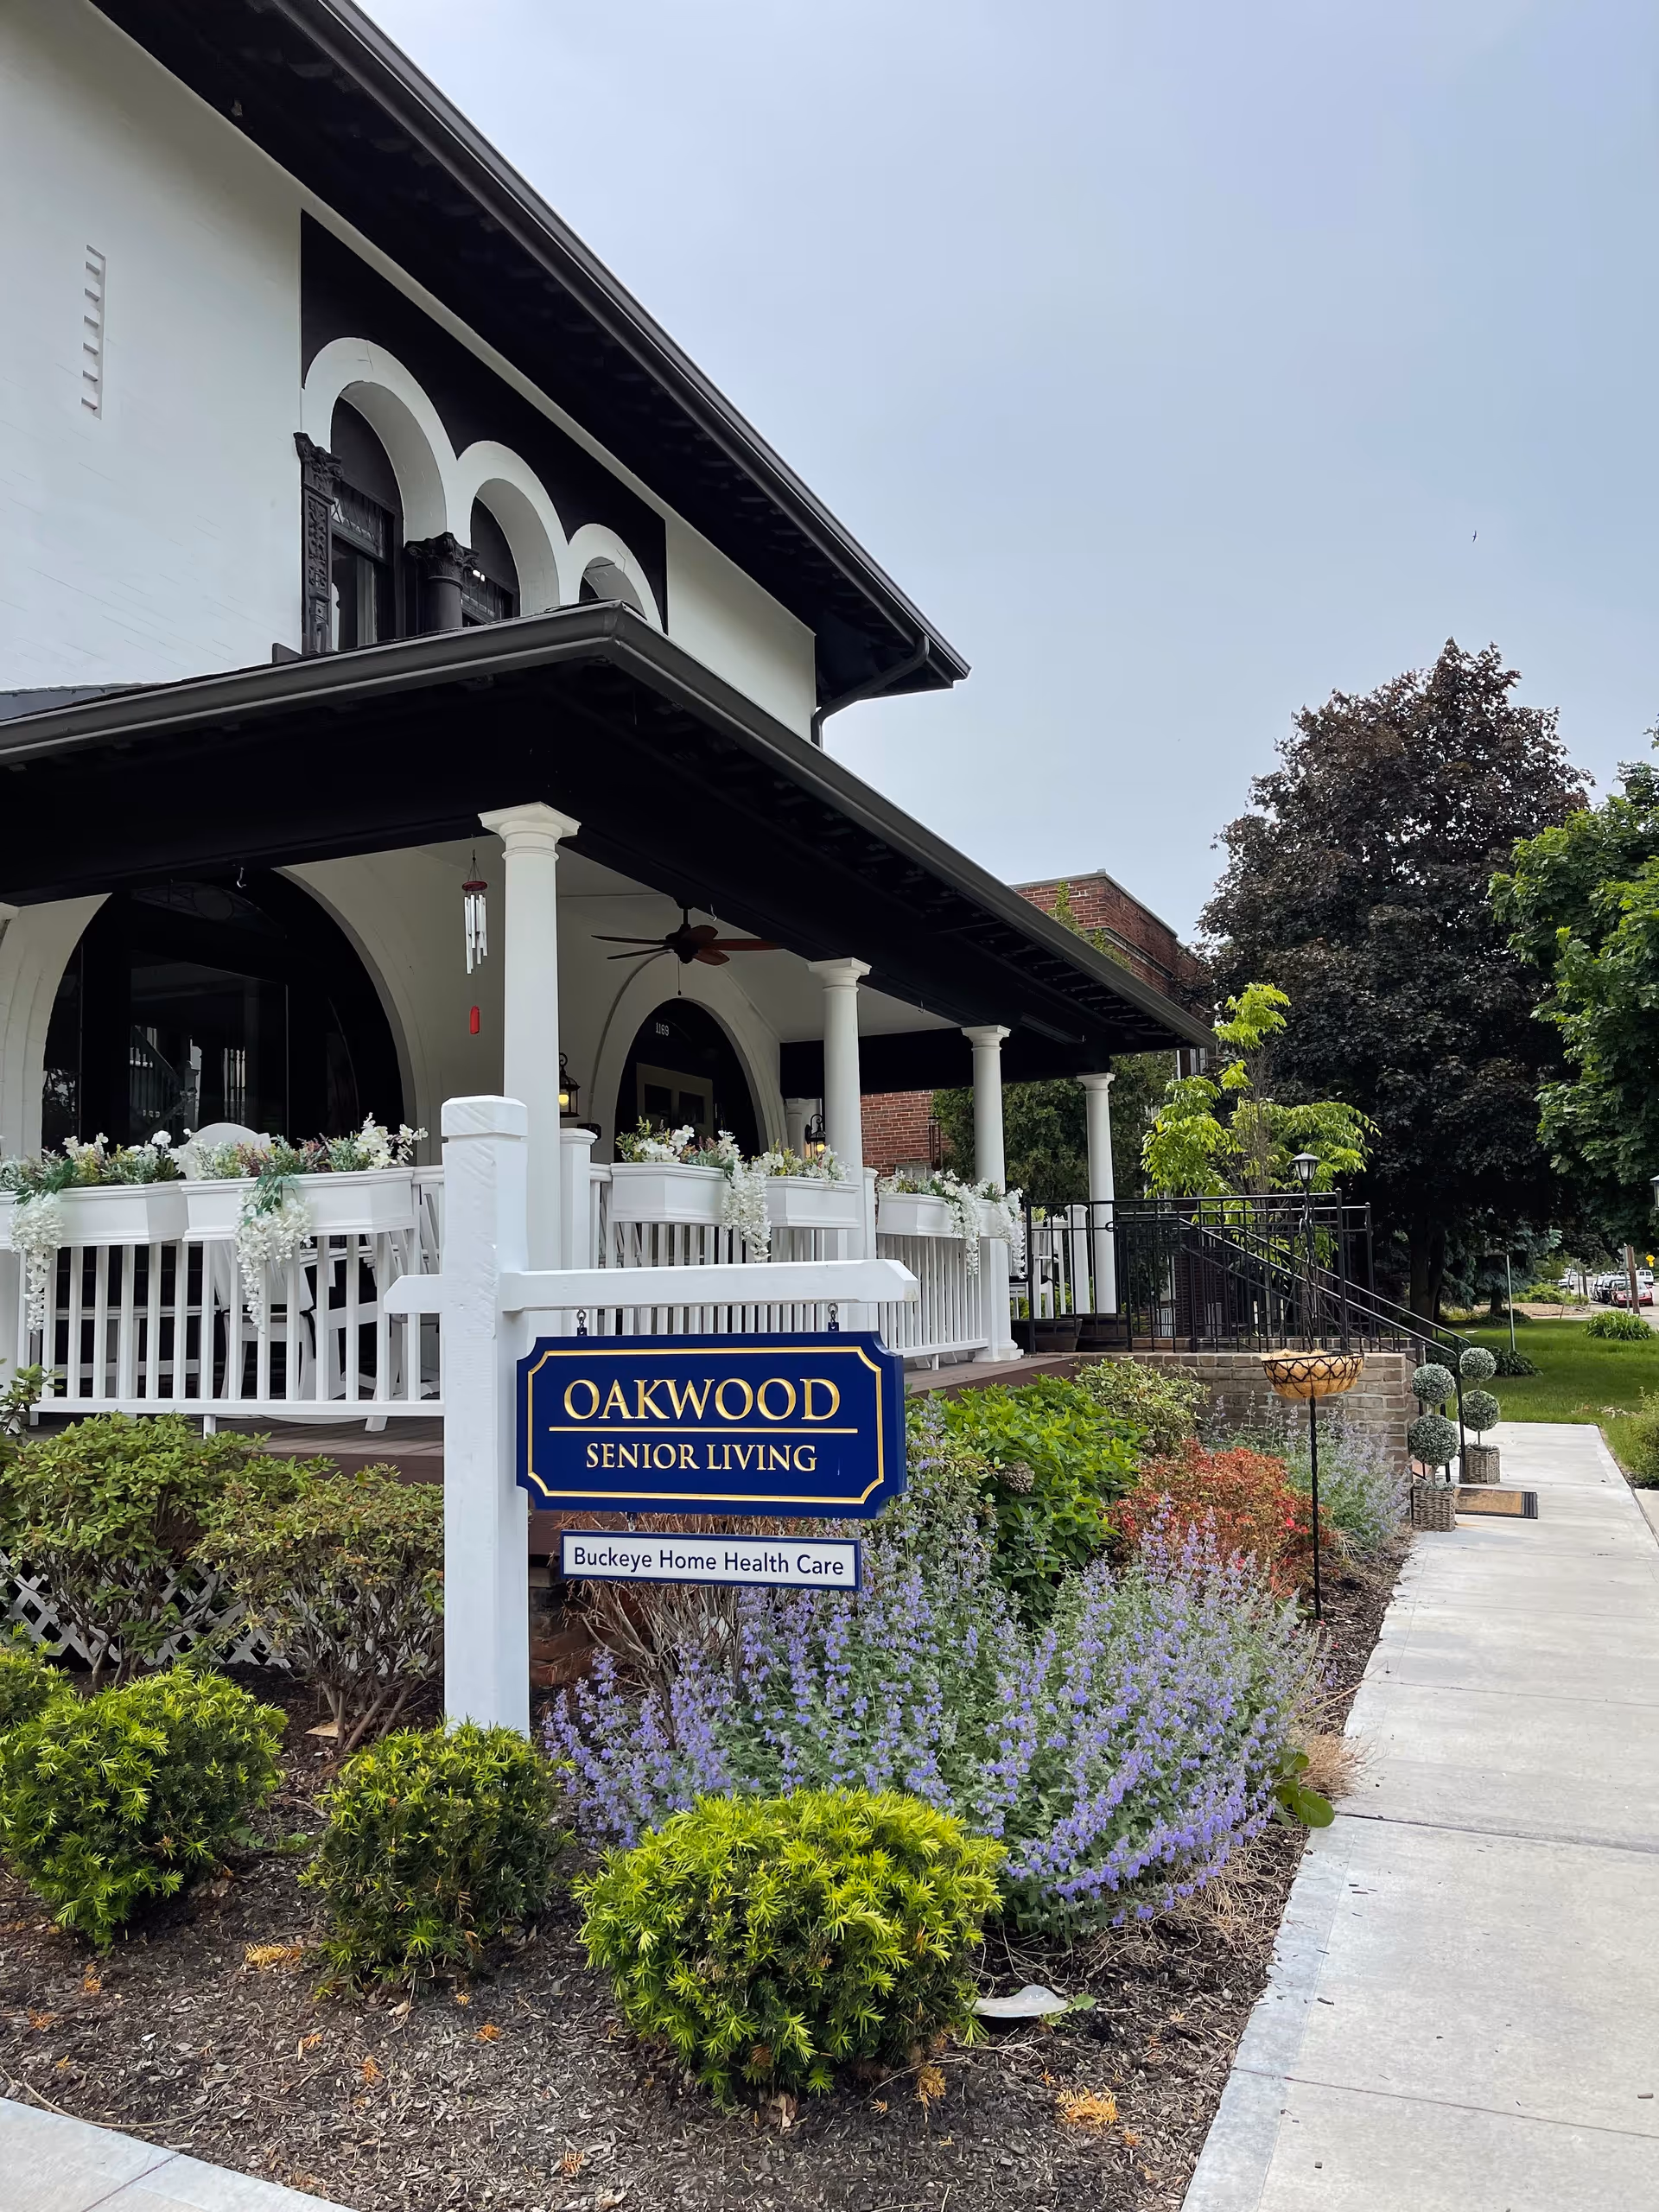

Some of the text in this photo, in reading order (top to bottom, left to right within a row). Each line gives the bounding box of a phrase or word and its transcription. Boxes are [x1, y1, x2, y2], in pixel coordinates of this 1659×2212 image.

[563, 1377, 841, 1421] OAKWOOD
[586, 1442, 817, 1471] SENIOR LIVING
[574, 1547, 844, 1575] Buckeye Home Health Care
